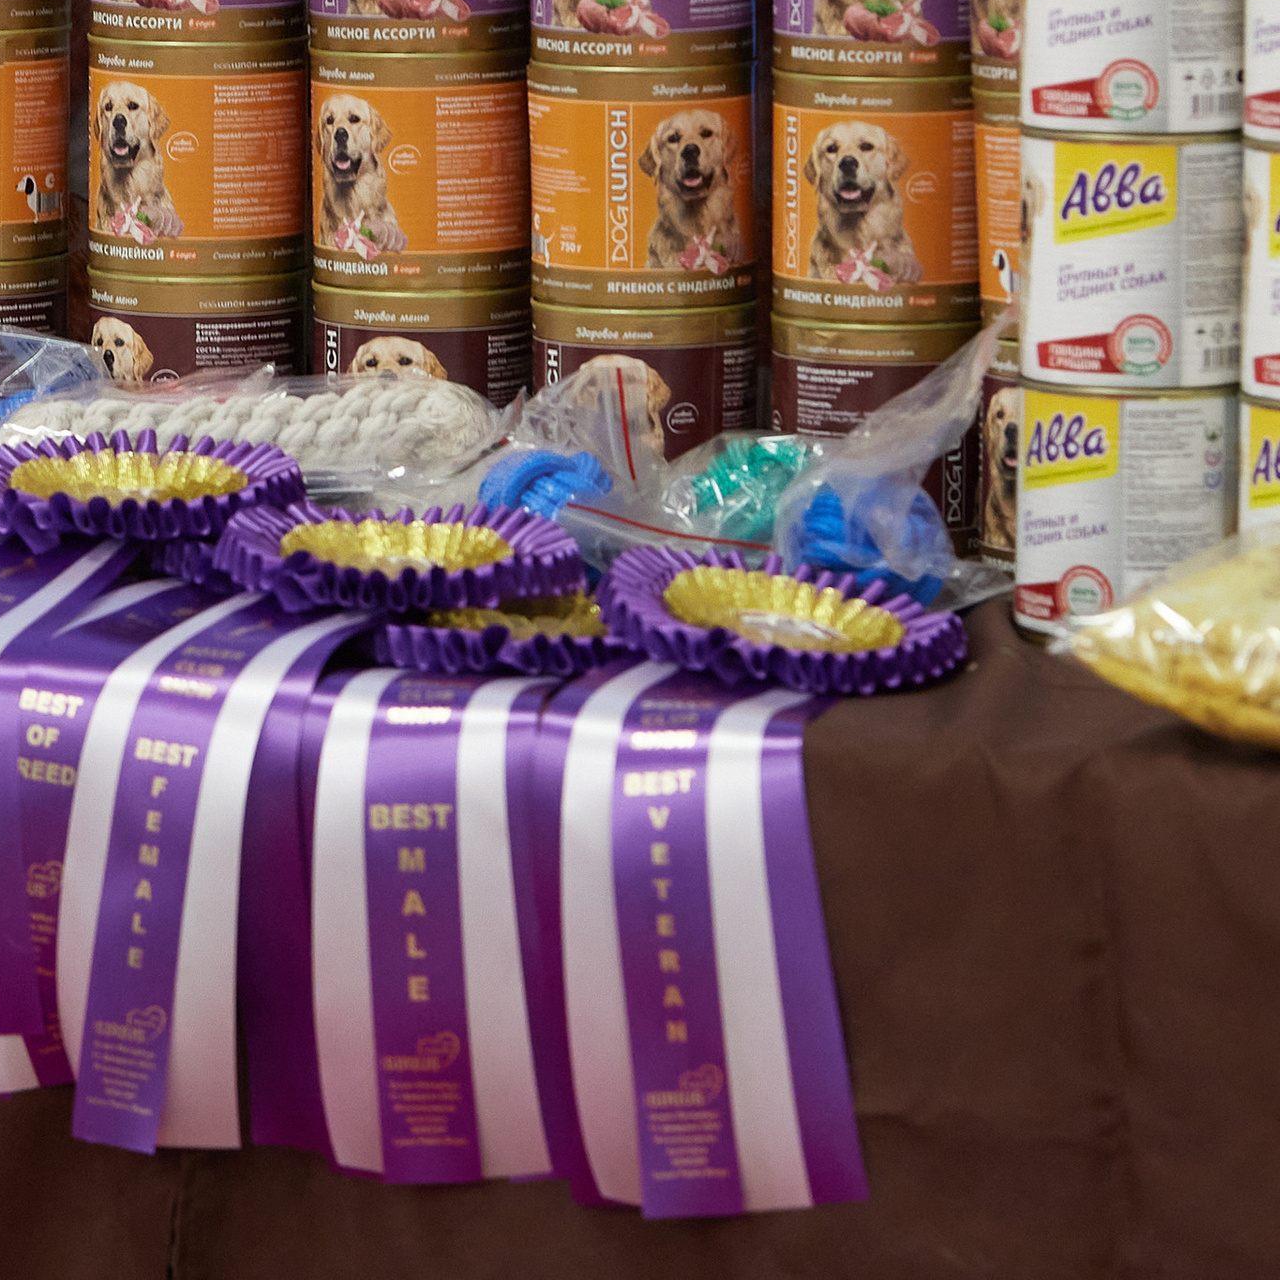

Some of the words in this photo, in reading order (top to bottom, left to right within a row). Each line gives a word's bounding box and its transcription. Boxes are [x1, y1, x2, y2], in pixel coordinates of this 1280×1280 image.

[93, 11, 123, 25] МЯСНОЕ
[126, 14, 182, 29] АССОРТИ
[328, 26, 370, 40] МЯСНОЕ
[374, 27, 435, 40] АССОРТИ
[537, 38, 570, 51] МЯСНОЕ
[573, 42, 632, 55] АССОРТИ
[792, 46, 835, 61] МЯСНОЕ
[838, 49, 902, 63] АССОРТИ
[111, 246, 164, 260] ИНДЕЙКОЙ
[335, 261, 387, 275] ИНДЕЙКОЙ
[608, 282, 663, 293] ЯГНЕНОК
[668, 284, 674, 292] С
[678, 277, 735, 293] ИНДЕЙКОЙ
[834, 295, 903, 308] ИНДЕЙКОЙ
[20, 687, 83, 719] BEST
[26, 722, 60, 750] OF
[135, 736, 199, 770] BEST
[17, 755, 76, 790] REED
[623, 768, 697, 798] BEST
[369, 802, 454, 832] BEST
[126, 776, 168, 971] FEMALE
[397, 846, 430, 1004] MALE
[647, 806, 689, 1045] VETERAN
